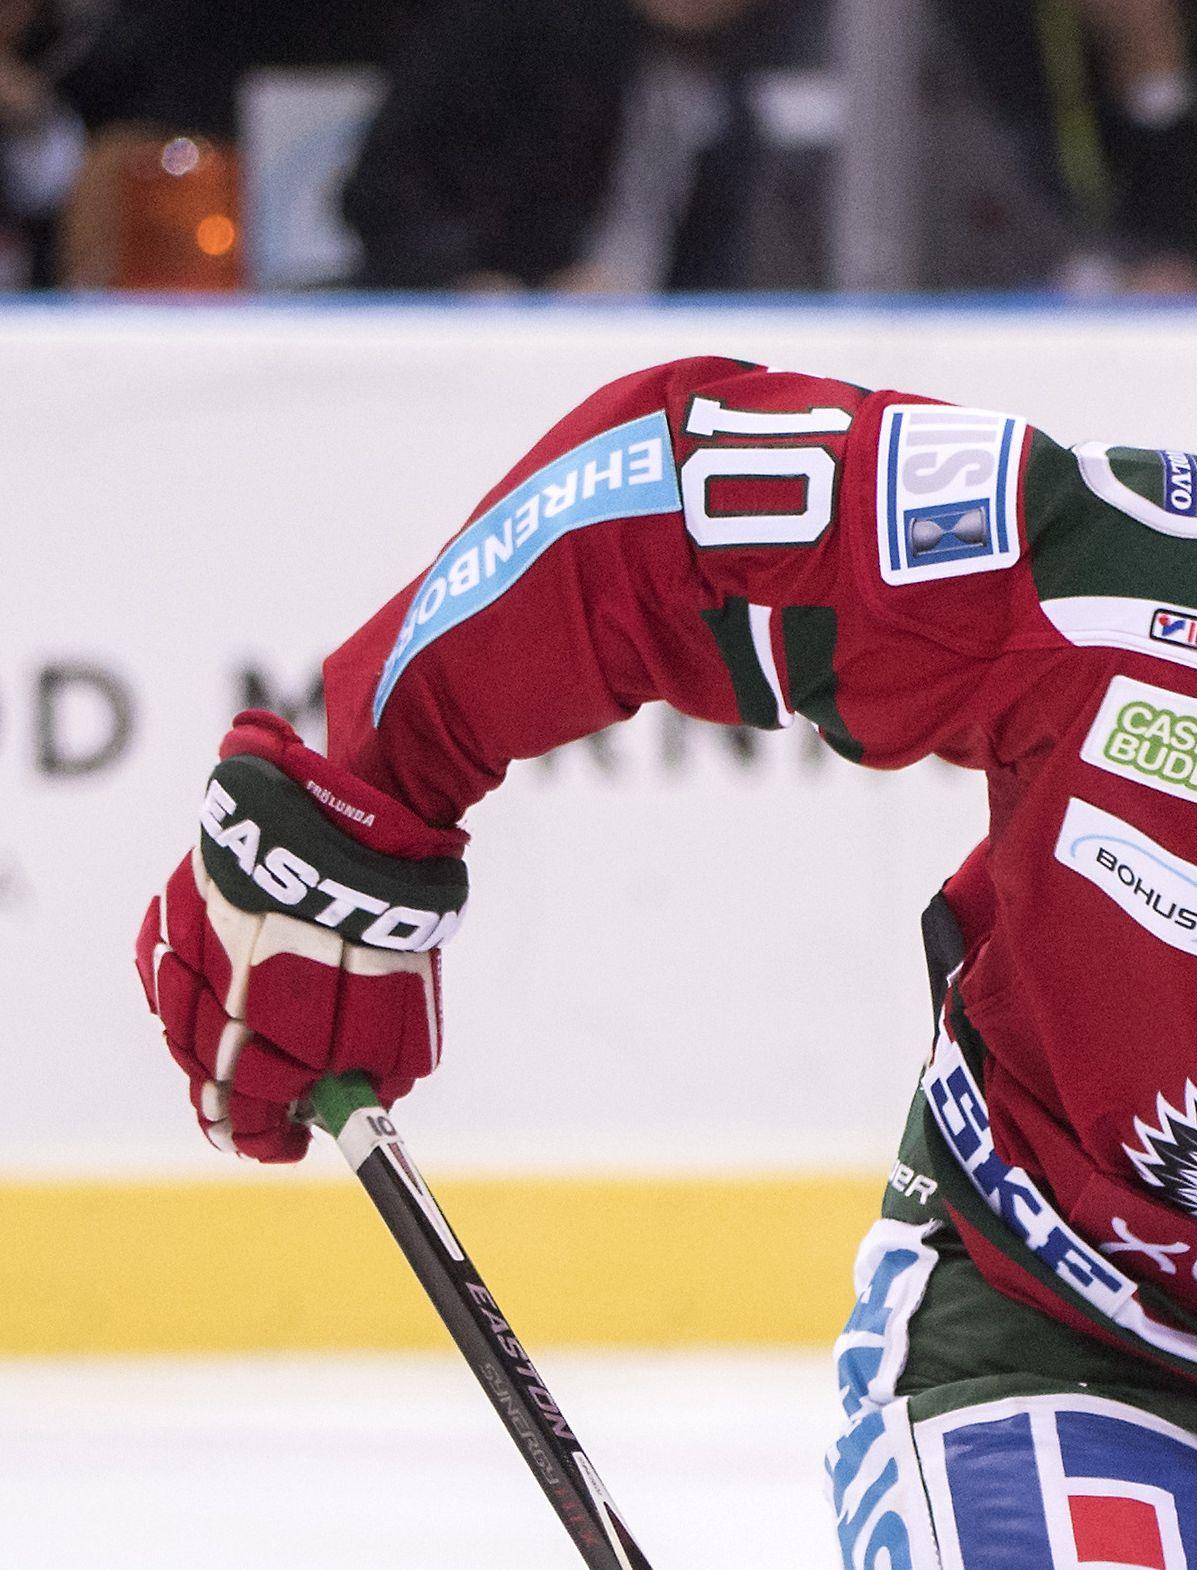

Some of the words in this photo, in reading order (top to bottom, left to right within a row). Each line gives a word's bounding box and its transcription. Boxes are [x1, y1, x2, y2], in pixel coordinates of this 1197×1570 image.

[681, 393, 854, 547] 10
[366, 1114, 398, 1138] 10
[928, 1064, 1124, 1296] SKF
[465, 1281, 577, 1442] EASTON
